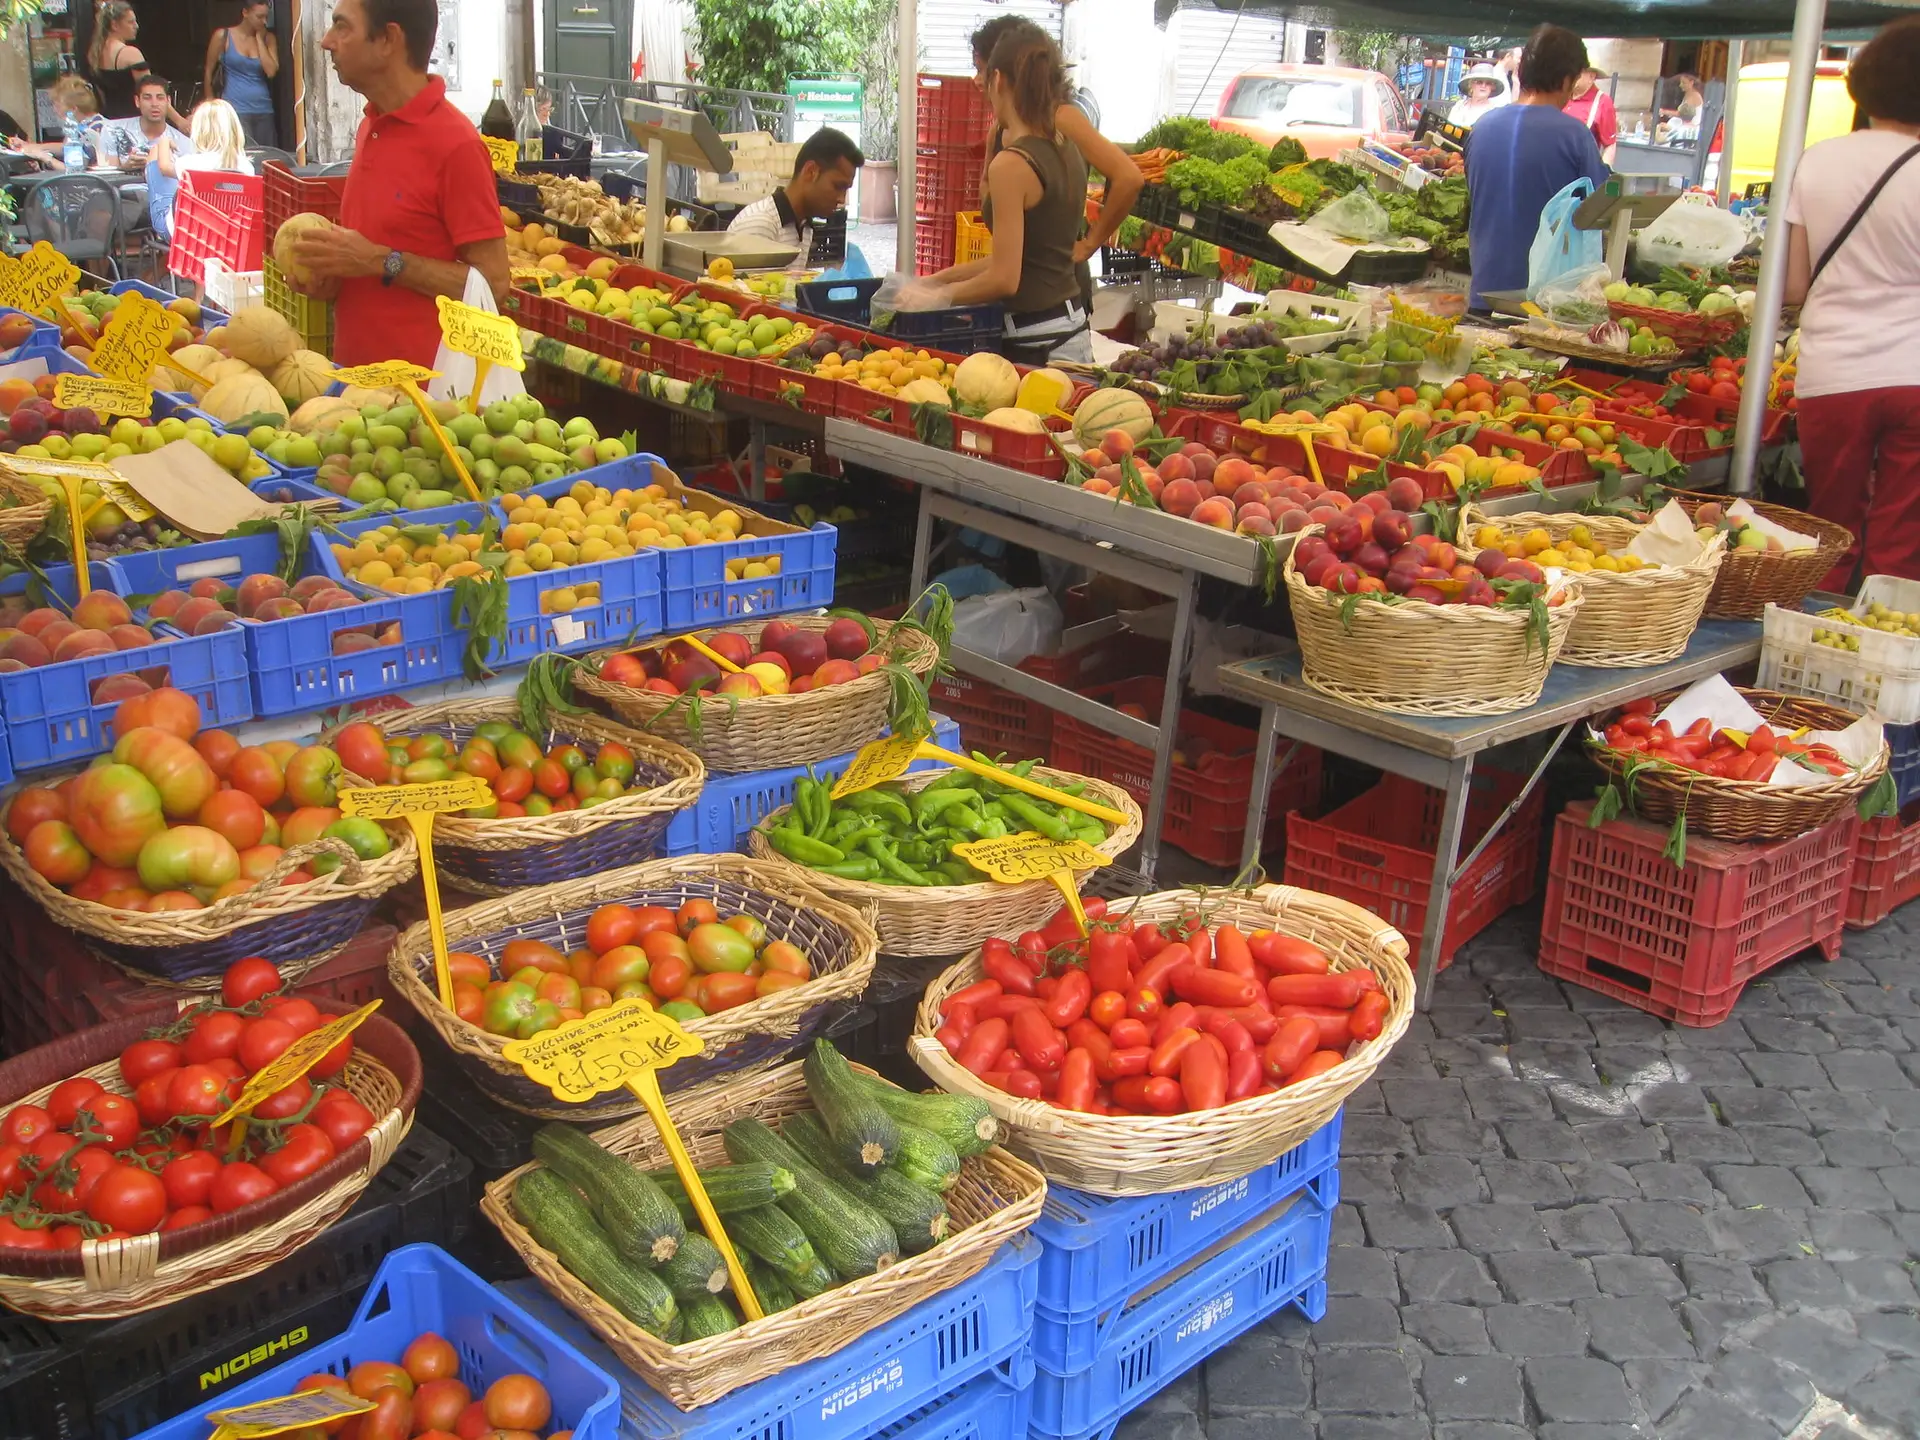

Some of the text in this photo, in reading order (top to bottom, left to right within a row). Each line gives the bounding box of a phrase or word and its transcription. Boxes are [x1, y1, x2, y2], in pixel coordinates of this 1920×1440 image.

[807, 91, 854, 101] Heineken
[1190, 1177, 1248, 1221] GHEDIN
[1176, 1297, 1234, 1343] GHEDIN
[199, 1325, 309, 1390] GHEDIN
[821, 1365, 904, 1421] GHEDIN
